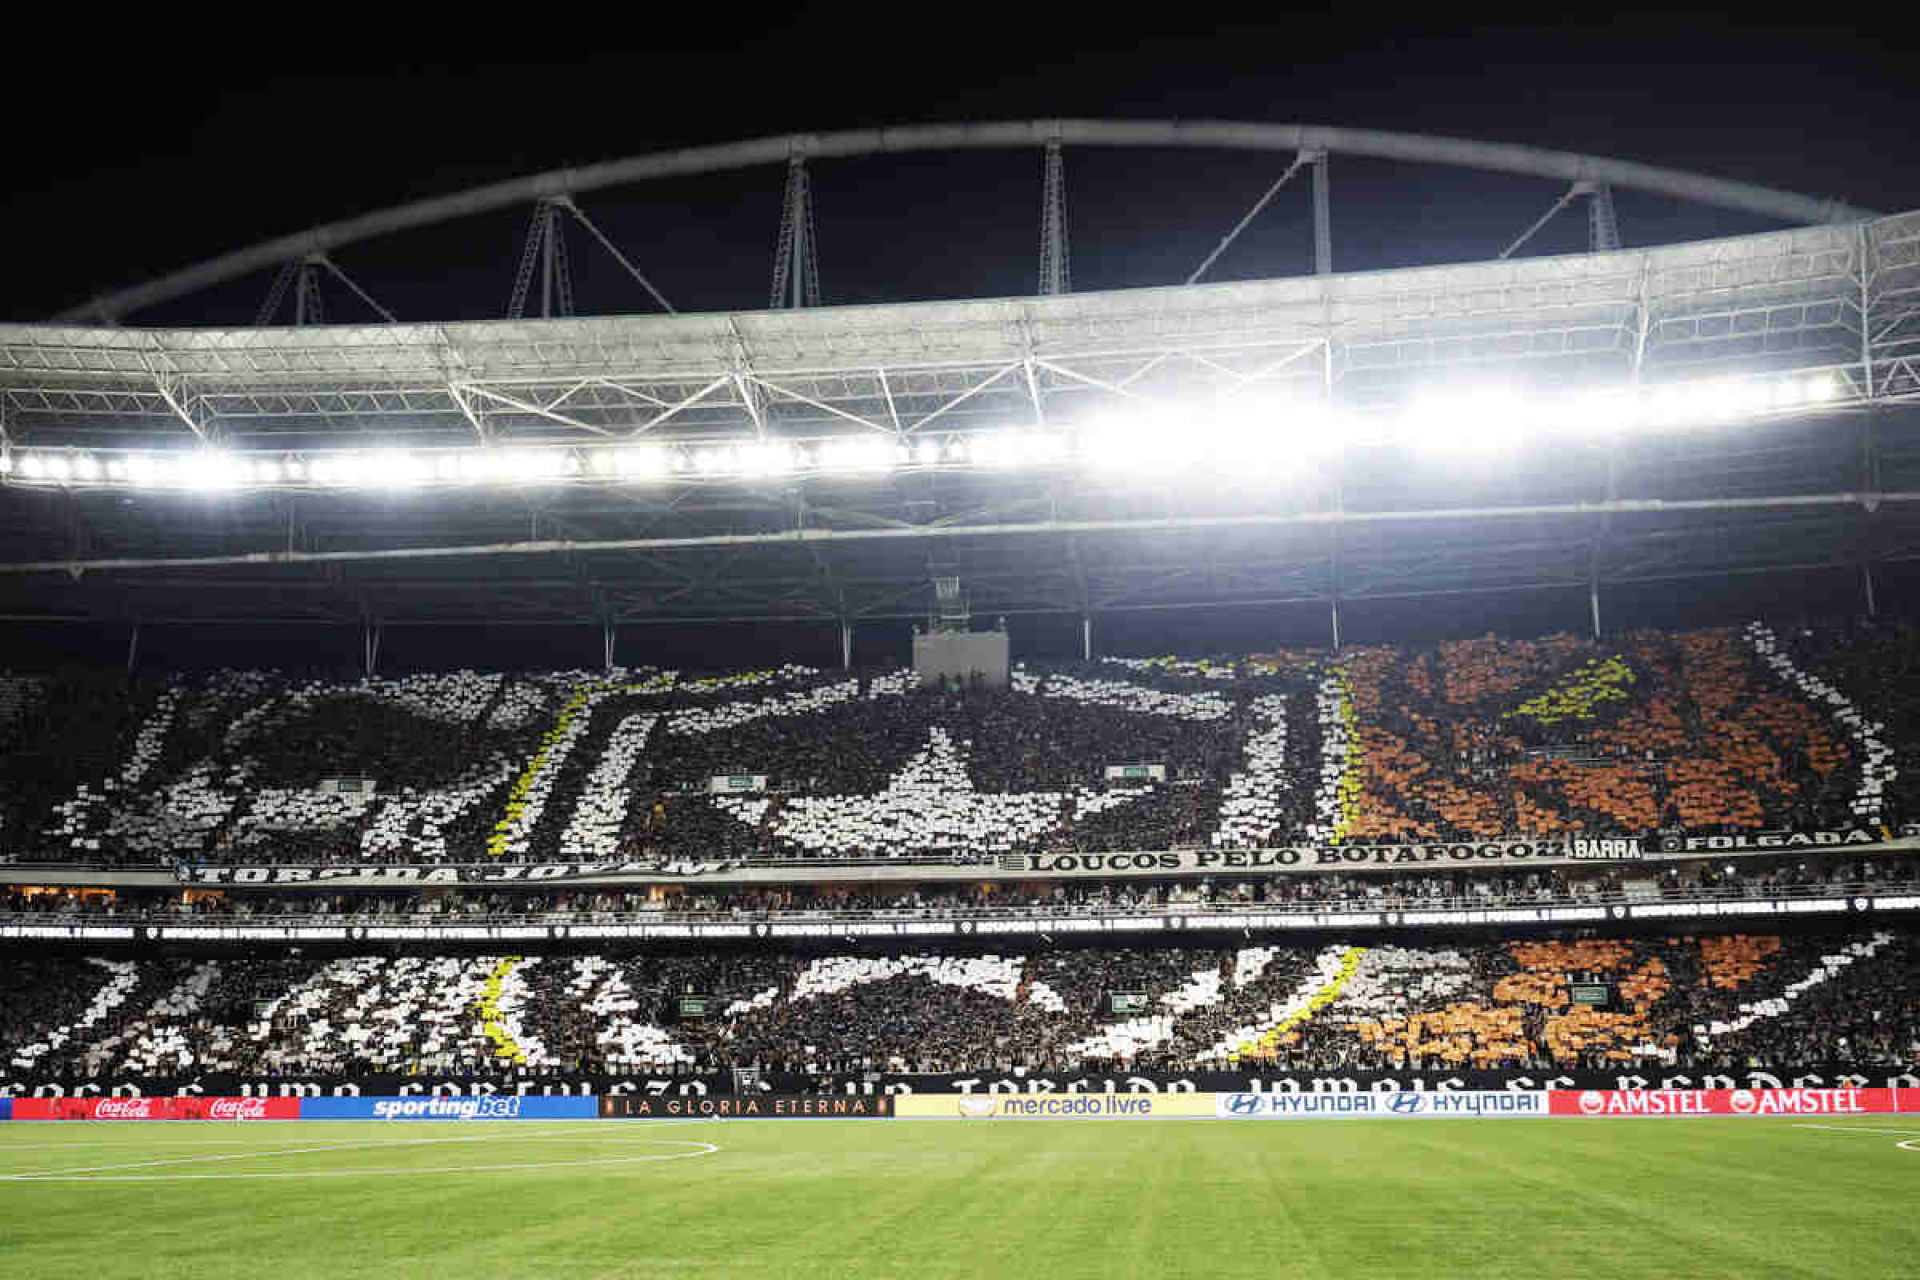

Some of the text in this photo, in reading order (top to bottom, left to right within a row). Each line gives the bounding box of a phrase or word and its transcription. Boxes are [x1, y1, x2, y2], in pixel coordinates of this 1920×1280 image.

[1574, 839, 1641, 858] BARRA
[1687, 830, 1873, 850] FOLGADA
[1028, 854, 1181, 871] LOUCOS
[1195, 849, 1300, 867] PELO
[1316, 843, 1533, 864] BOTAFOGO
[373, 1096, 521, 1118] sportingbet
[626, 1100, 866, 1115] LA GLORIA ETERNA
[1003, 1096, 1152, 1115] mercado livre
[1272, 1095, 1376, 1112] HYUNDAI
[1434, 1094, 1540, 1112] HYUNDAI
[1607, 1091, 1710, 1113] AMSTEL
[1758, 1090, 1866, 1113] AMSTEL
